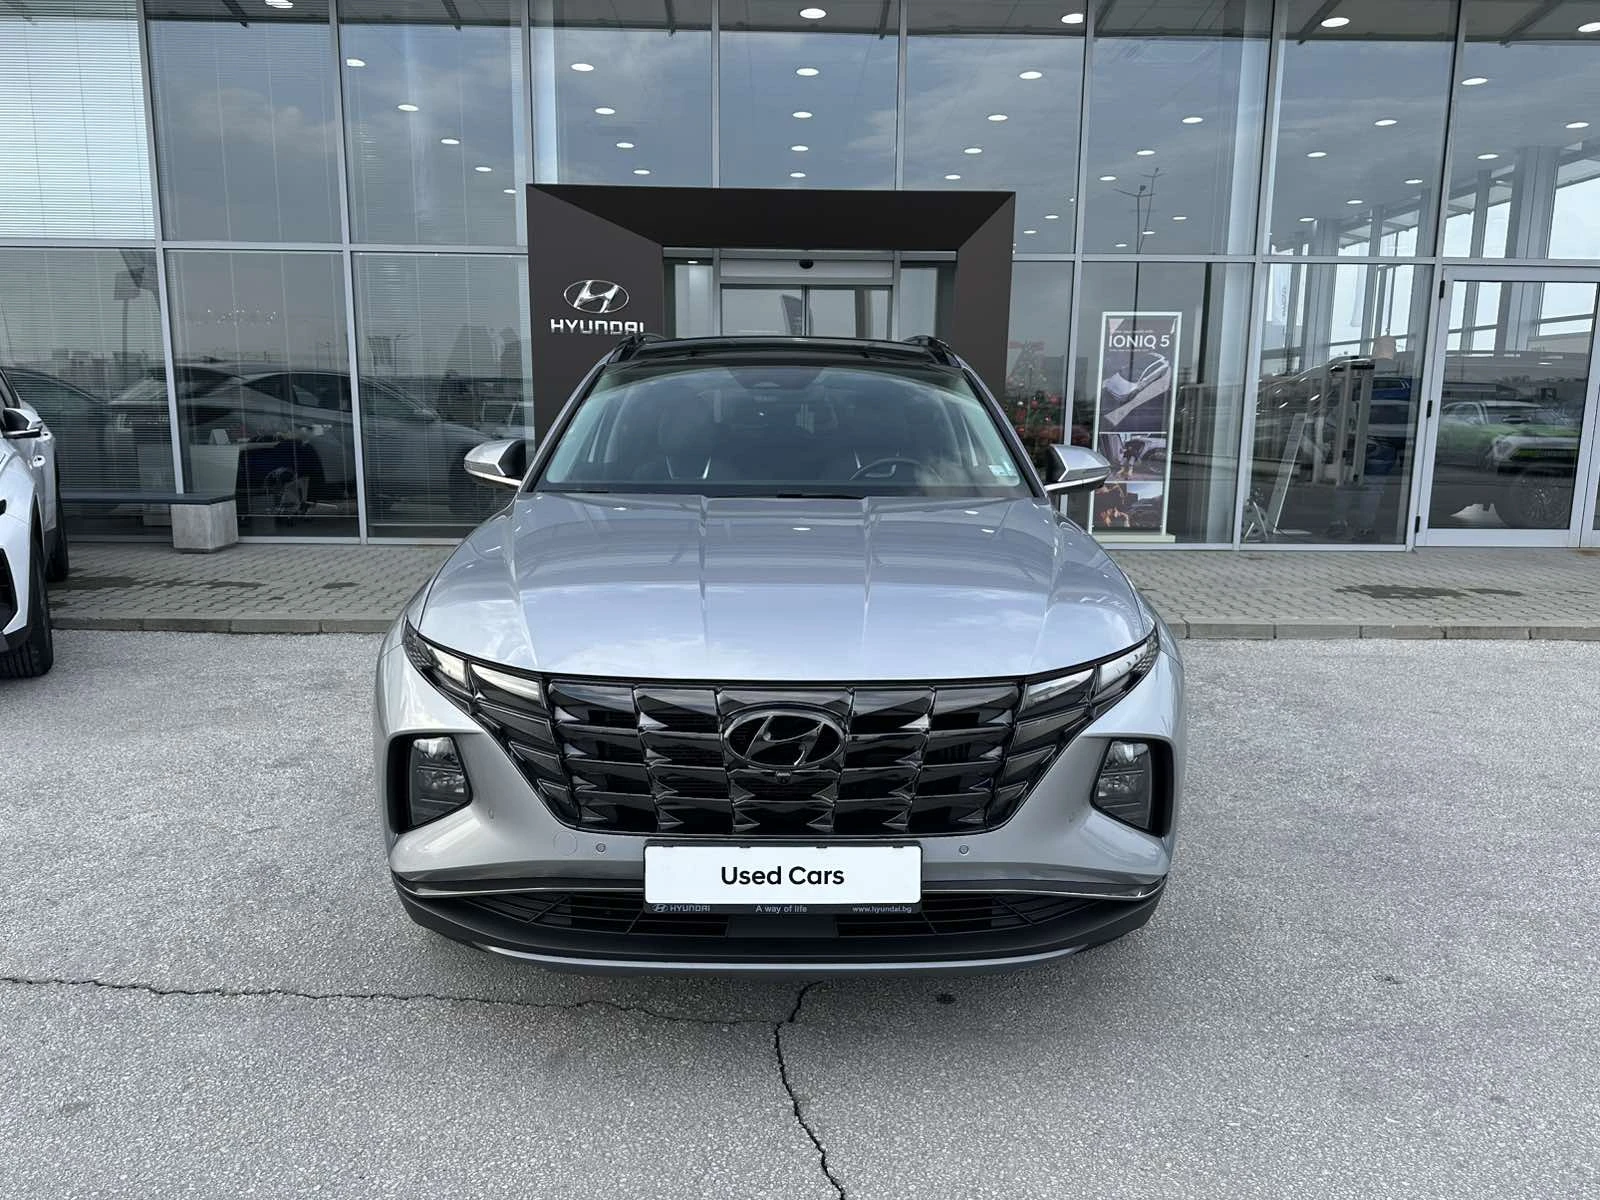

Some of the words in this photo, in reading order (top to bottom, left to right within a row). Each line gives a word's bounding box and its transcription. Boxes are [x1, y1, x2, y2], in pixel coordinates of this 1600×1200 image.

[550, 319, 644, 335] HYUNDAI
[1108, 334, 1156, 349] IONIQ
[1160, 334, 1170, 347] 5
[721, 866, 782, 885] Used
[788, 866, 845, 885] Cars
[669, 904, 711, 912] HYUNDAI
[755, 905, 762, 913] A
[764, 906, 781, 914] way
[783, 905, 792, 913] of
[794, 904, 808, 913] life
[852, 905, 912, 914] www.hyundai.bg
